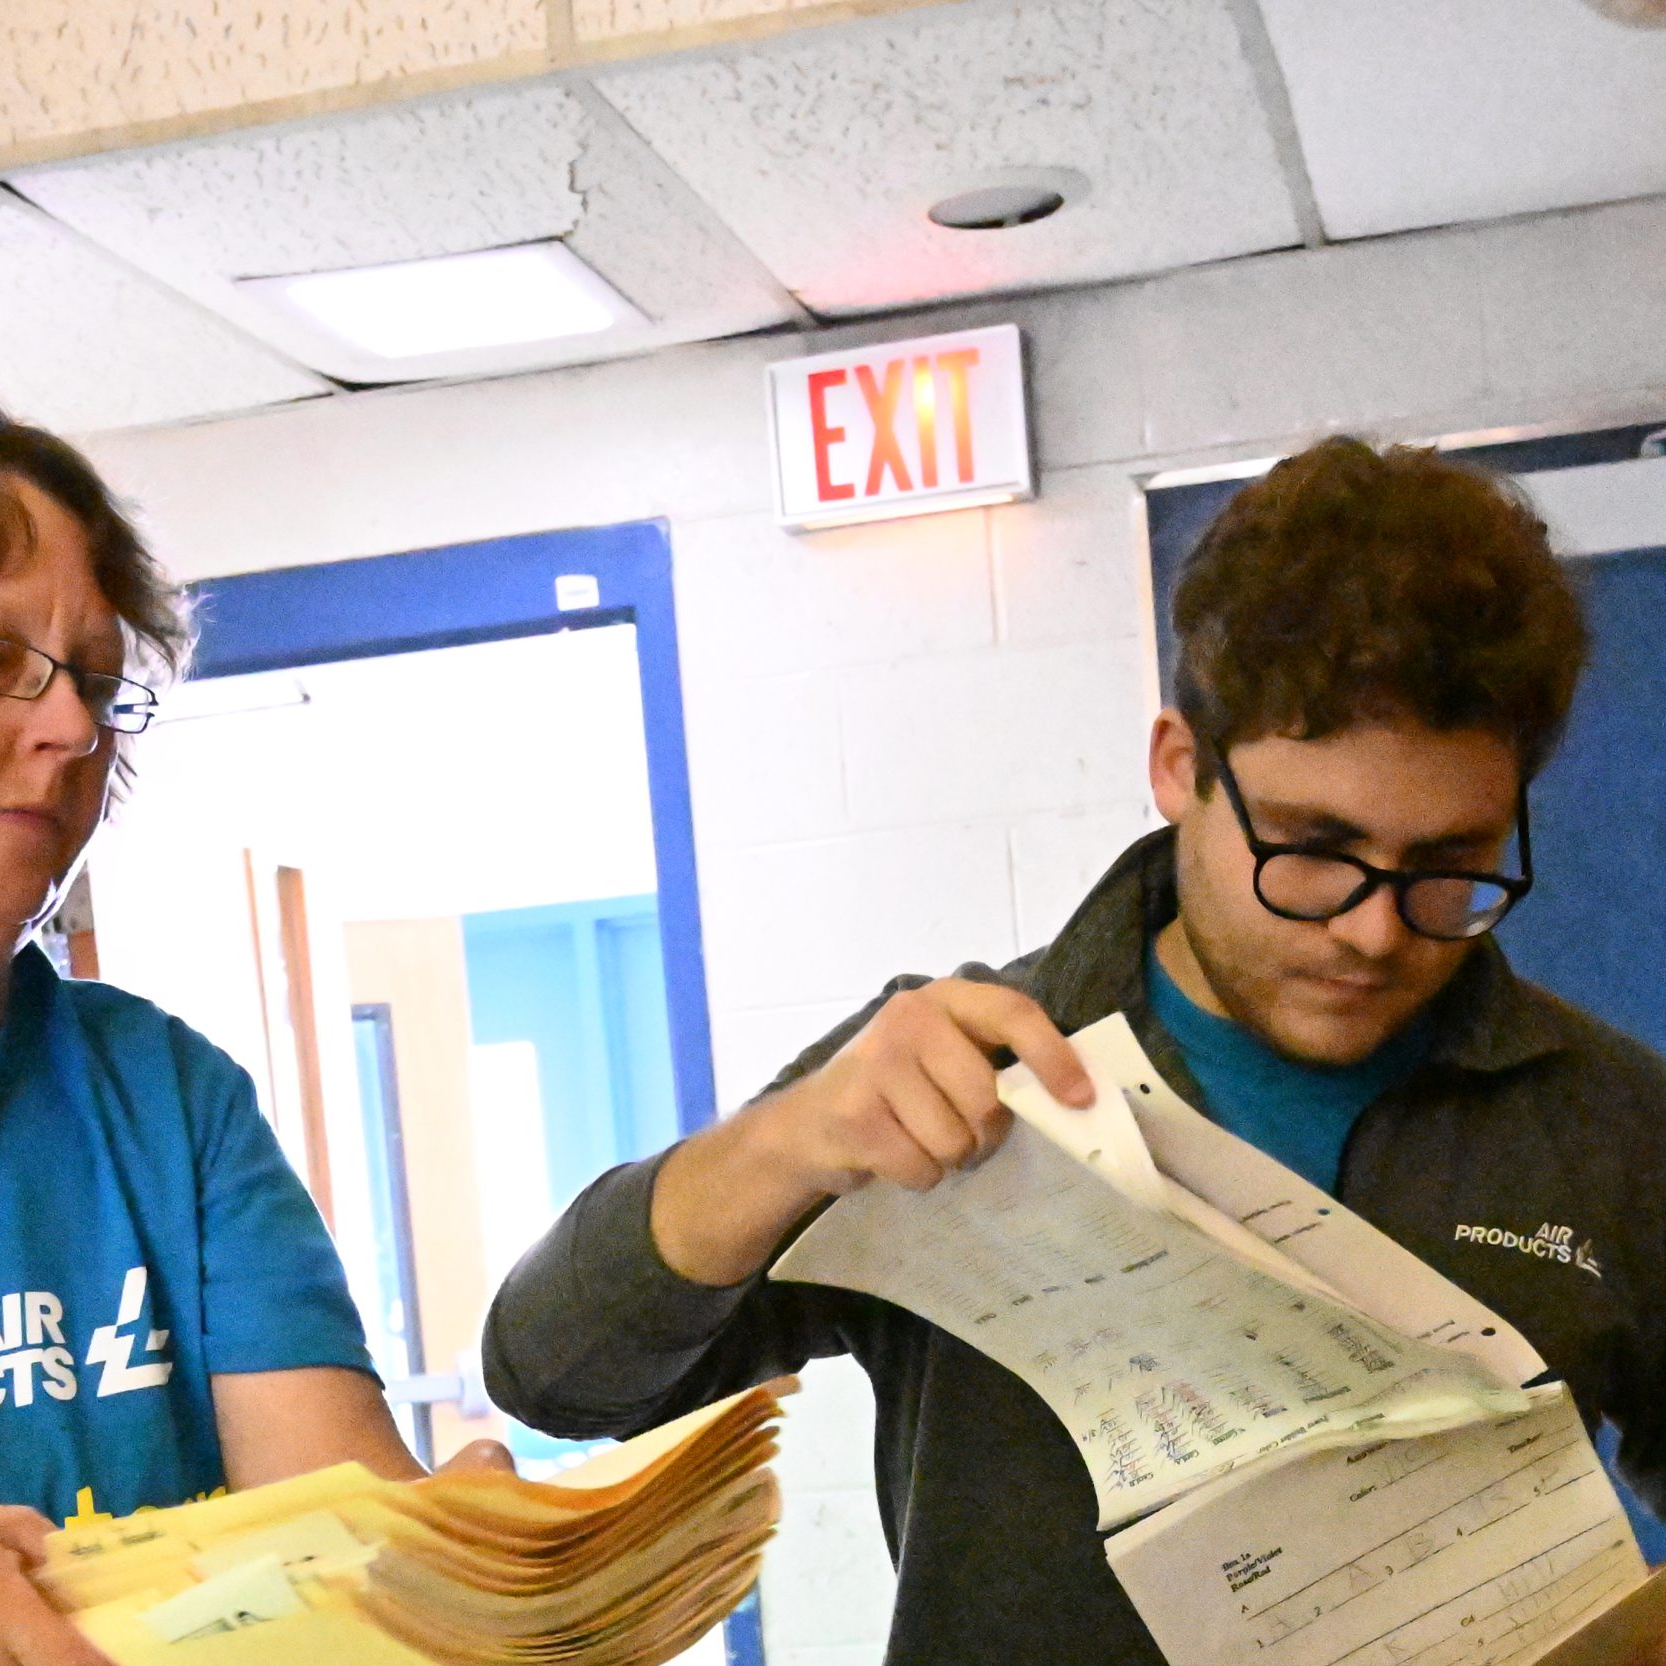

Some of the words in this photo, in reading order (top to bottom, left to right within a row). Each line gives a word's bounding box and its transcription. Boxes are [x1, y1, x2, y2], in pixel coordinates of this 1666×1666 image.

[808, 347, 980, 502] EXIT
[1454, 1224, 1572, 1263] PRODUCTS
[1535, 1222, 1574, 1245] AIR
